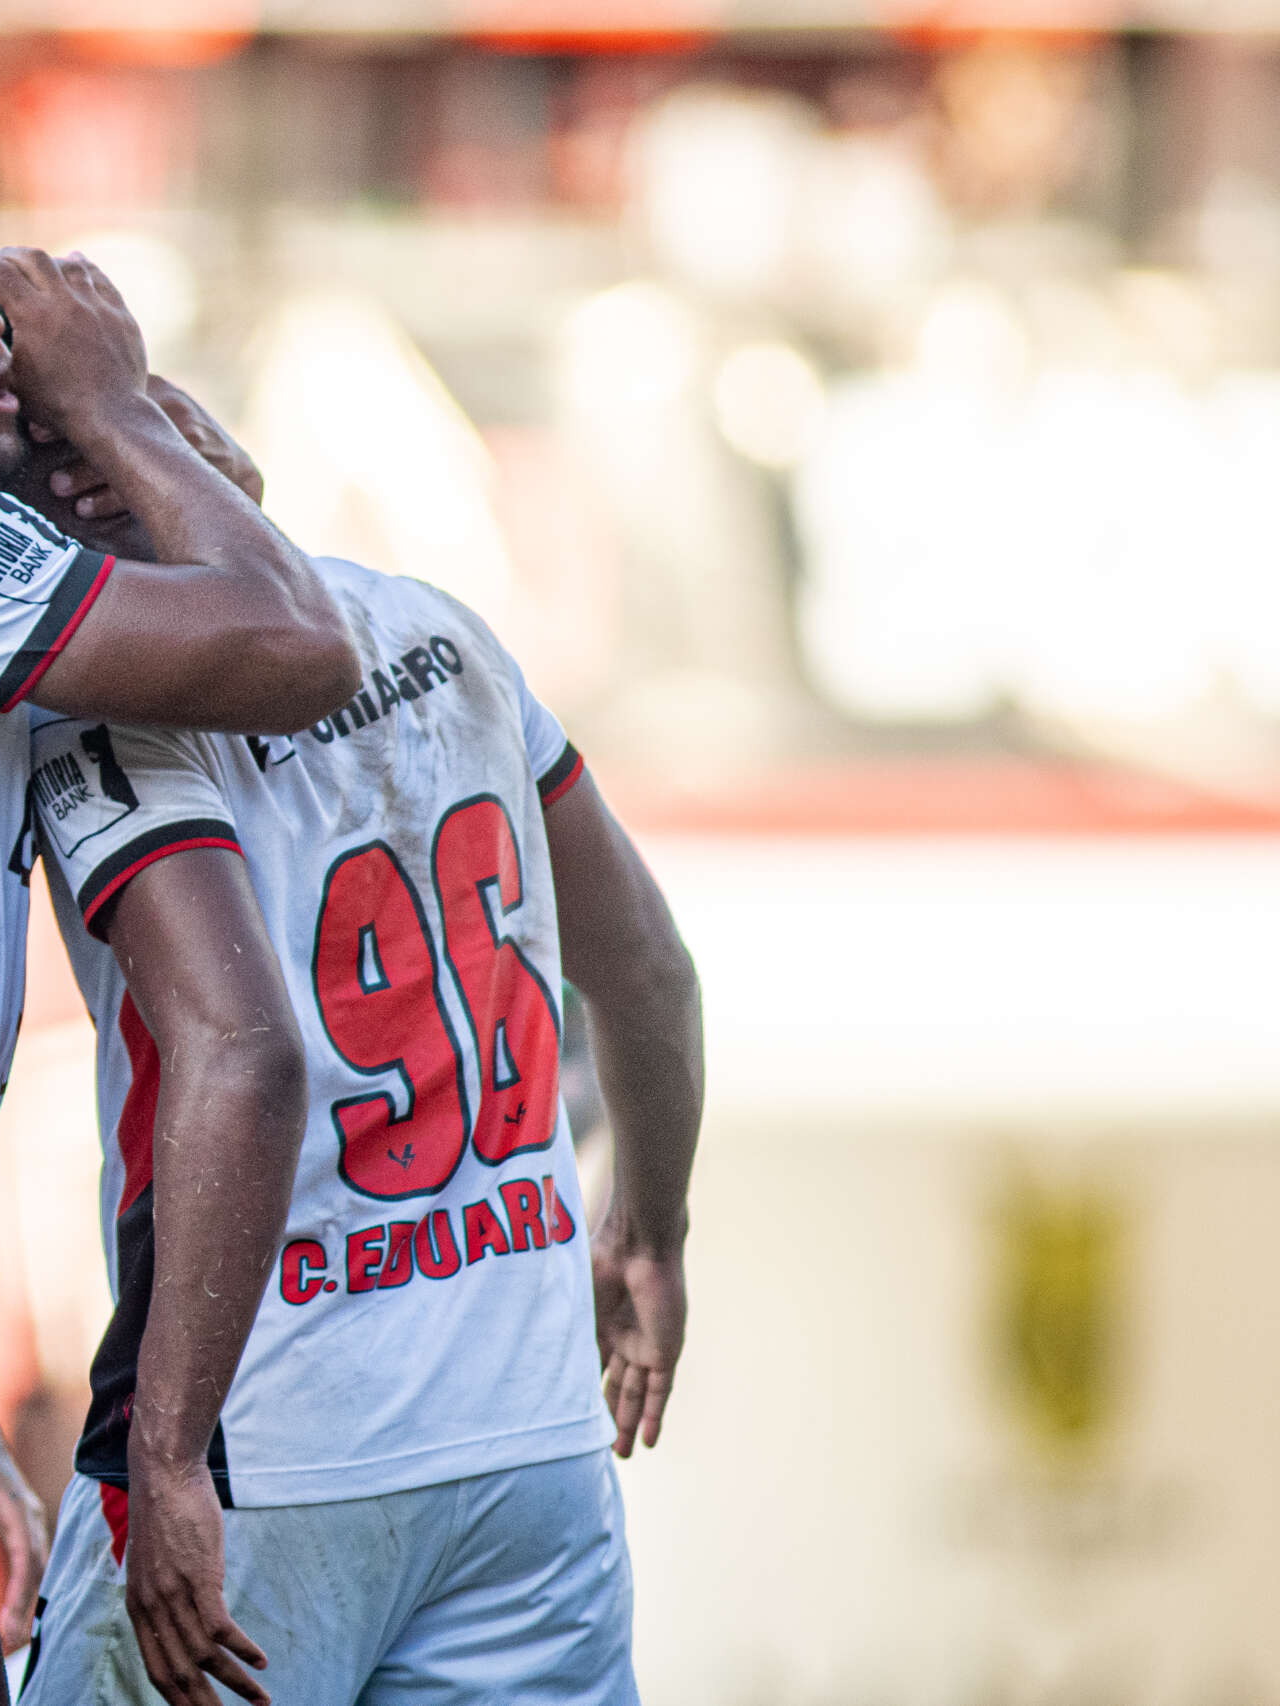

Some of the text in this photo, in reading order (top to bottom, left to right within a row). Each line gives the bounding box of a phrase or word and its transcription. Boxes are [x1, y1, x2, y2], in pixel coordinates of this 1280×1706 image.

[10, 542, 53, 585] BANK
[52, 785, 95, 821] BANK
[312, 792, 562, 1201] 96
